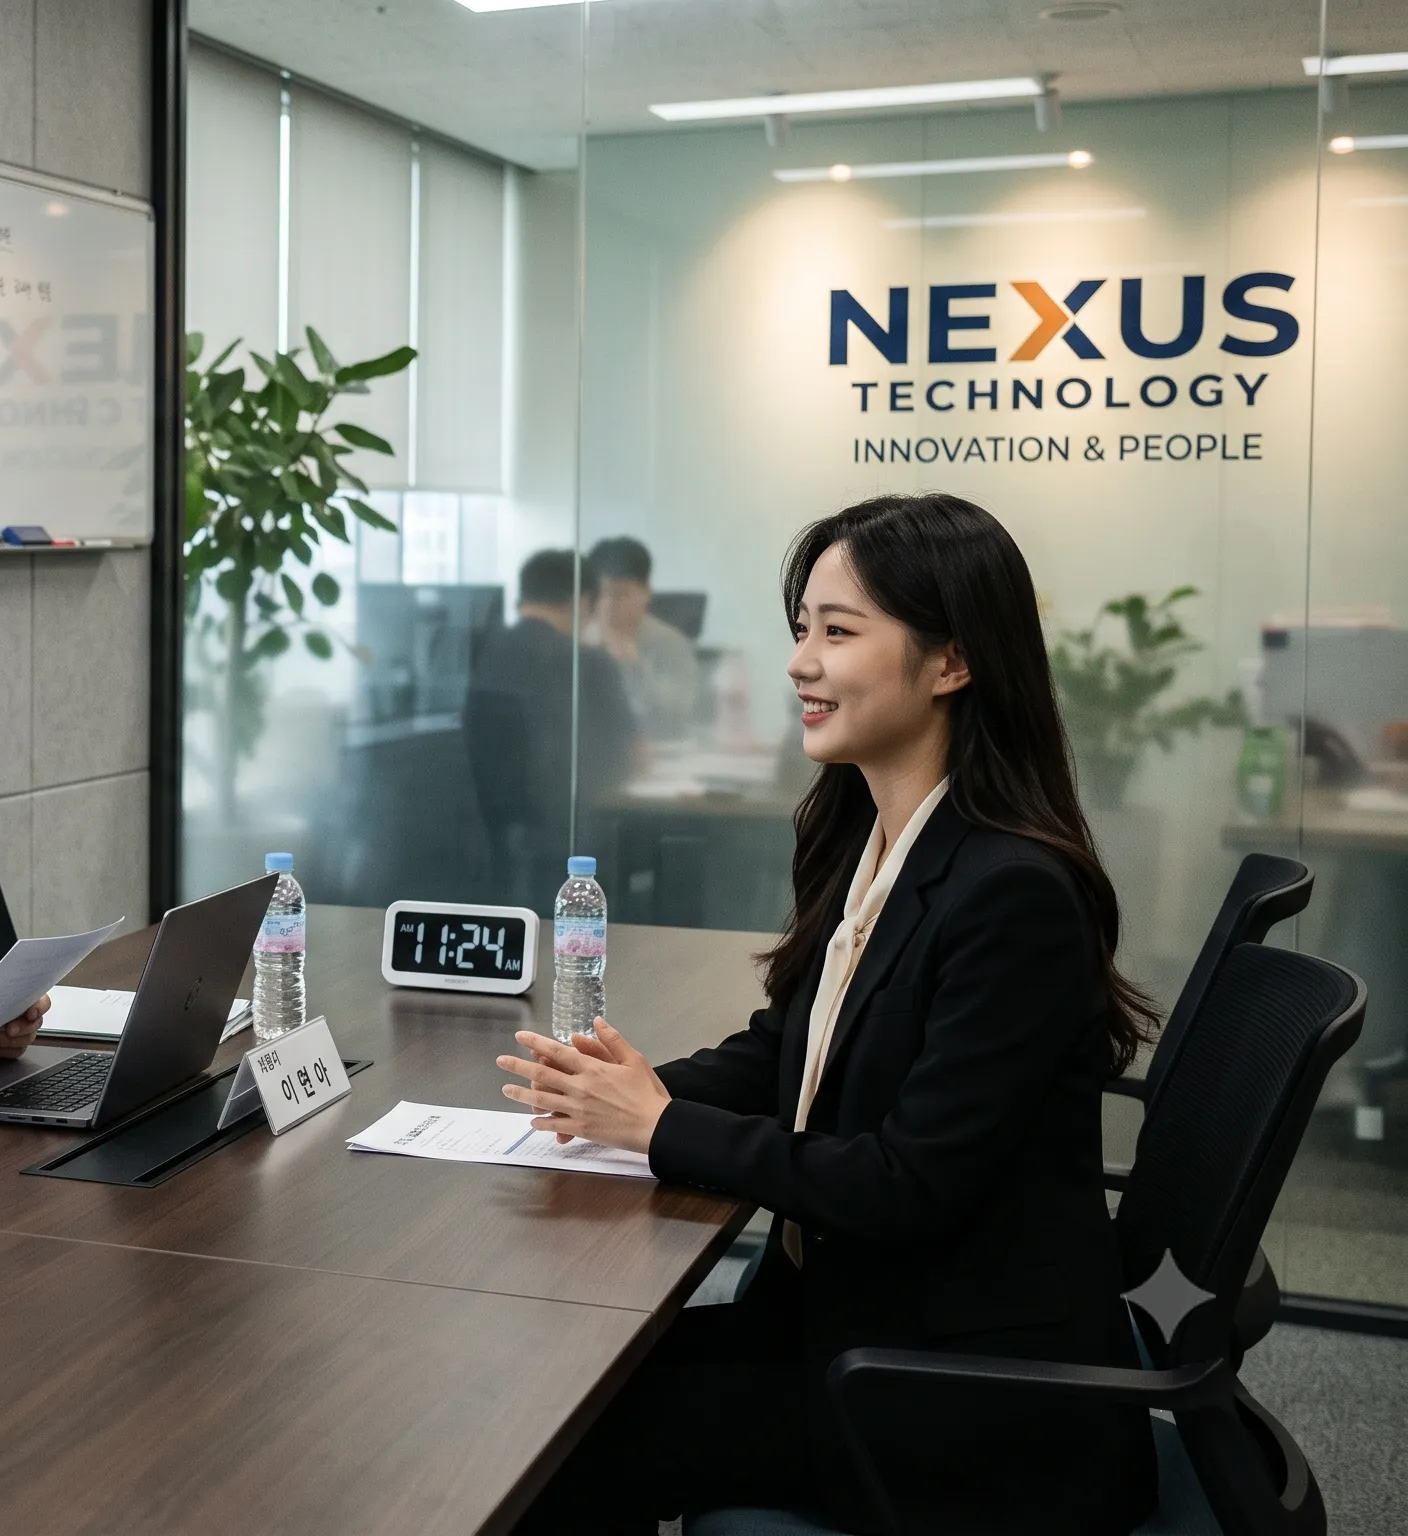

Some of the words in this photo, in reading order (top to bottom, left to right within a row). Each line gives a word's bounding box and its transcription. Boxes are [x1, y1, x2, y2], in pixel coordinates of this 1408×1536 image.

[828, 271, 1300, 366] NEXUS
[851, 373, 1269, 413] TECHNOLOGY
[854, 436, 1069, 464] INNOVATION
[1084, 436, 1105, 462] &
[1119, 434, 1263, 461] PEOPLE
[400, 924, 414, 933] AM
[415, 922, 506, 970] 11:24
[505, 959, 521, 971] AM
